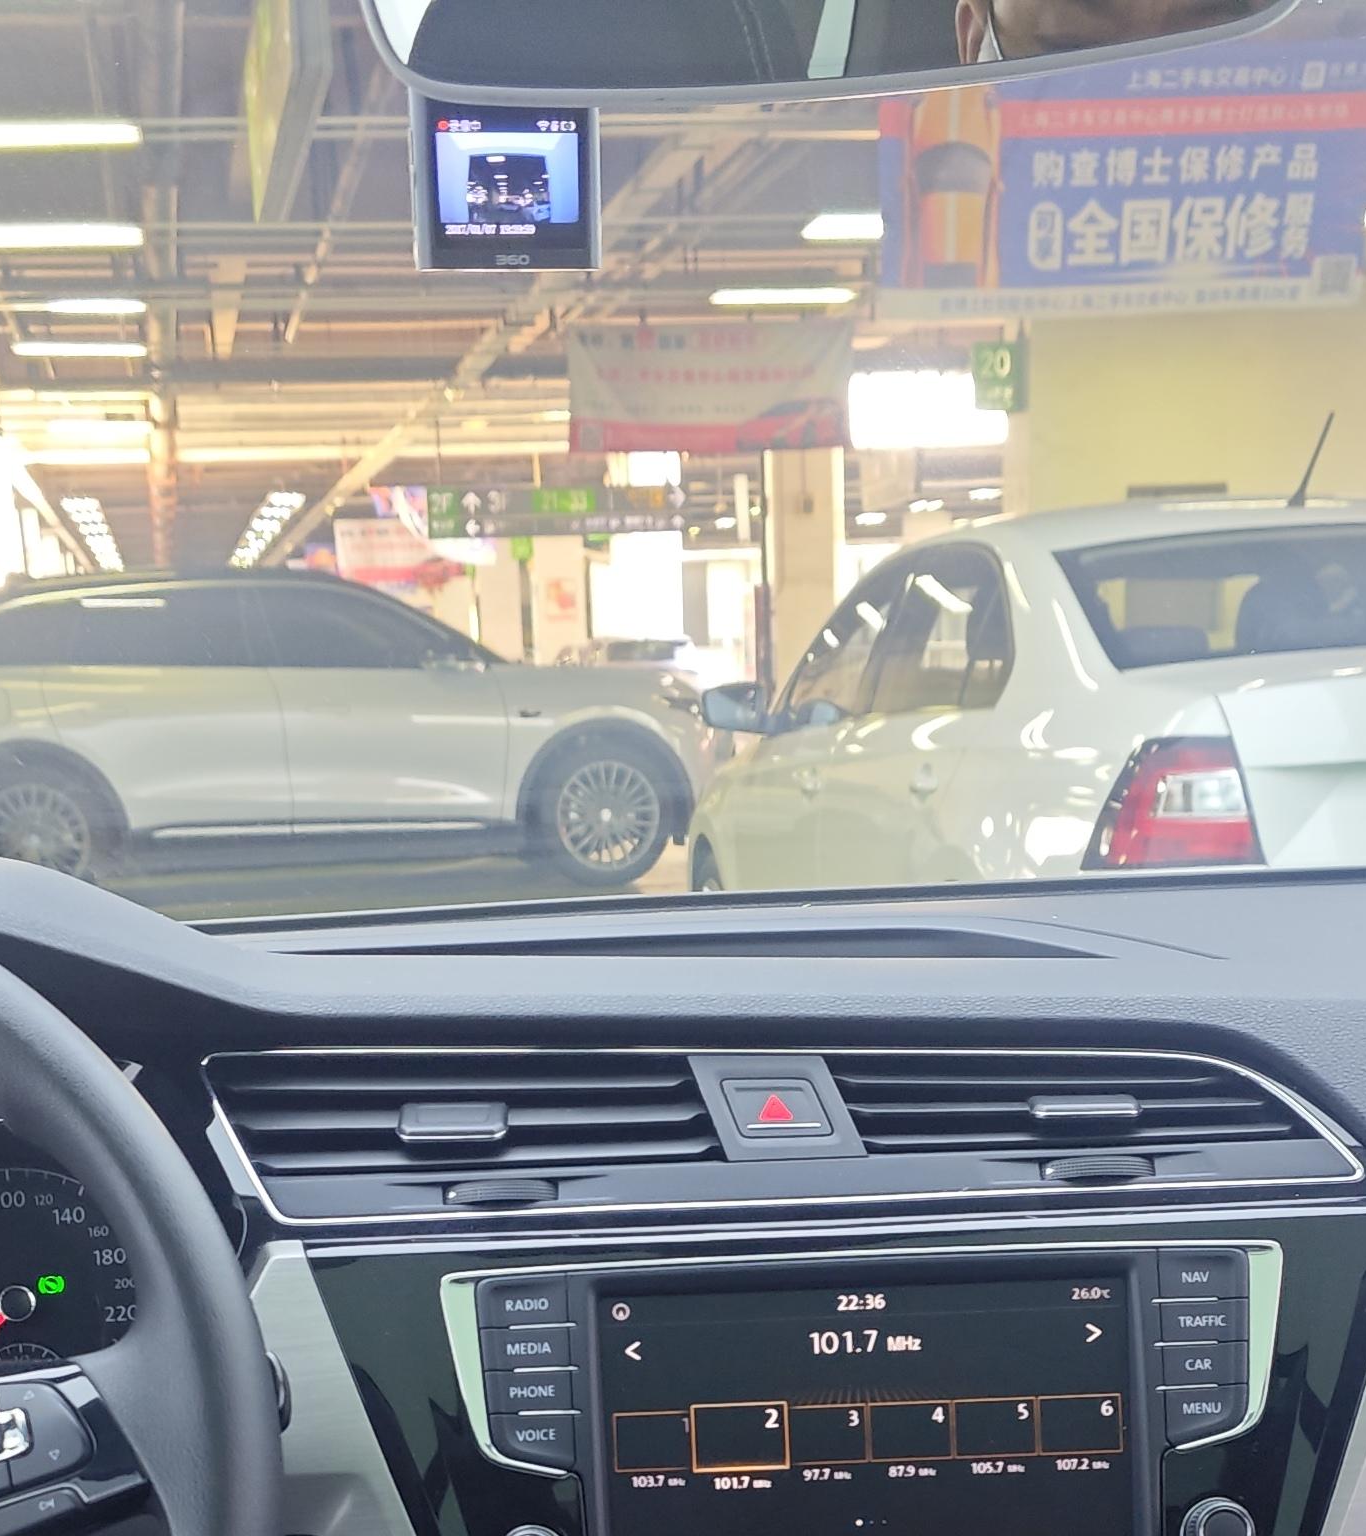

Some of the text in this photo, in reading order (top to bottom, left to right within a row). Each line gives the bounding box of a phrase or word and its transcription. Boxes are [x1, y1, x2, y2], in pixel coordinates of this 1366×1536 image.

[1031, 142, 1319, 188] 购查博士保修产品
[1066, 194, 1280, 267] 全国保修
[495, 254, 530, 266] 360
[979, 347, 1012, 379] 20
[34, 1193, 54, 1206] 120
[52, 1206, 85, 1225] 140
[88, 1225, 109, 1239] 160
[93, 1248, 126, 1266] 180
[1181, 1271, 1210, 1284] NAV
[505, 1297, 549, 1313] RADIO
[836, 1293, 886, 1311] 22:36
[1178, 1314, 1228, 1328] TRAFFIC
[506, 1341, 552, 1356] MEDIA
[808, 1329, 923, 1355] 101.7 MHz
[1185, 1358, 1213, 1372] CAR
[509, 1385, 556, 1399] PHONE
[931, 1406, 945, 1423] 4
[1017, 1402, 1030, 1420] 5
[1099, 1399, 1114, 1417] 6
[1182, 1402, 1222, 1415] MENU
[763, 1408, 780, 1429] 2
[847, 1410, 860, 1427] 3
[515, 1428, 556, 1442] VOICE
[887, 1464, 916, 1478] 87.9
[970, 1461, 1004, 1475] 105.7
[1055, 1457, 1089, 1471] 107.2
[631, 1474, 665, 1488] 103.7
[802, 1468, 831, 1481] 97.7
[713, 1476, 750, 1490] 101.7
